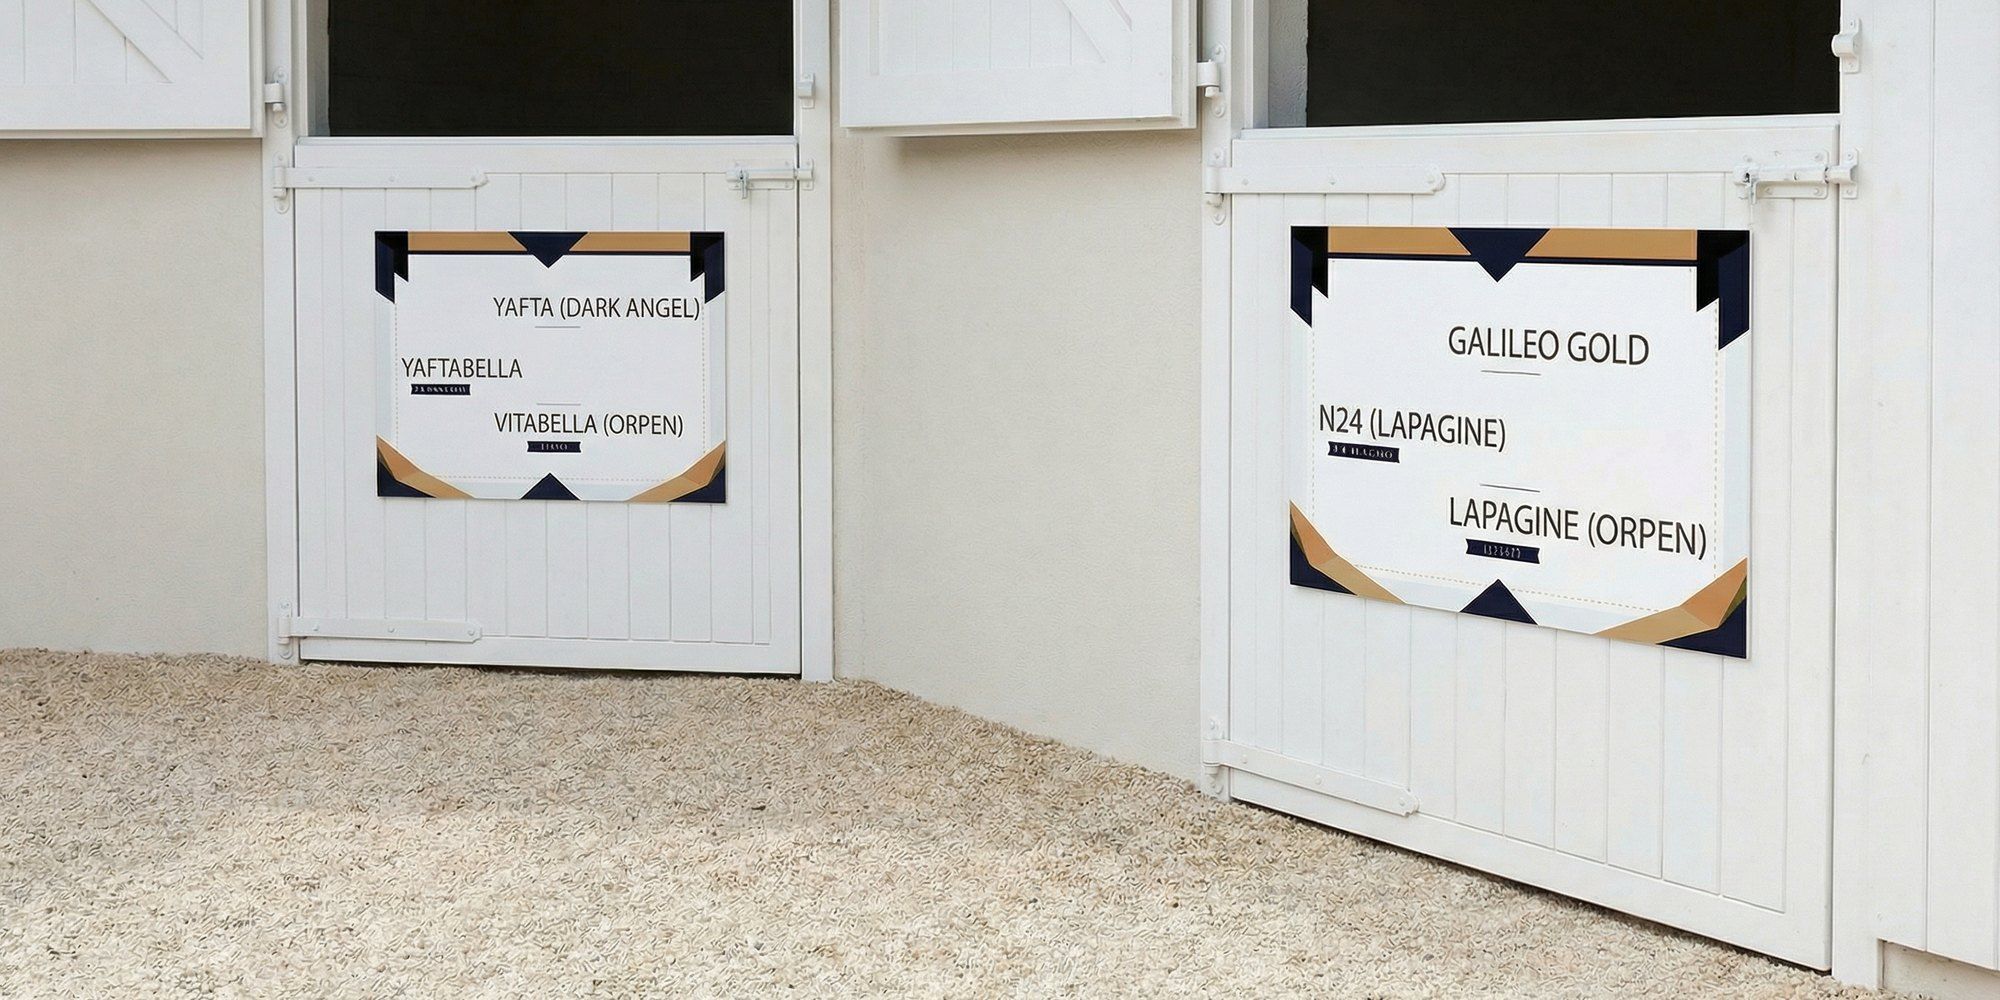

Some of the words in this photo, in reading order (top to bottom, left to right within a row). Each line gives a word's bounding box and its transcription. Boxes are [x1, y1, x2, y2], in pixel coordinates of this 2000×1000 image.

[492, 297, 554, 318] YAFTA
[560, 296, 621, 321] (DARK
[625, 297, 700, 321] ANGEL)
[1448, 326, 1560, 361] GALILEO
[1567, 331, 1650, 366] GOLD
[401, 357, 523, 379] YAFTABELLA
[493, 412, 598, 434] VITABELLA
[603, 413, 684, 438] (ORPEN)
[1319, 404, 1363, 435] N24
[1370, 407, 1506, 453] (LAPAGINE)
[1450, 496, 1579, 541] LAPAGINE
[1588, 512, 1707, 561] (ORPEN)
